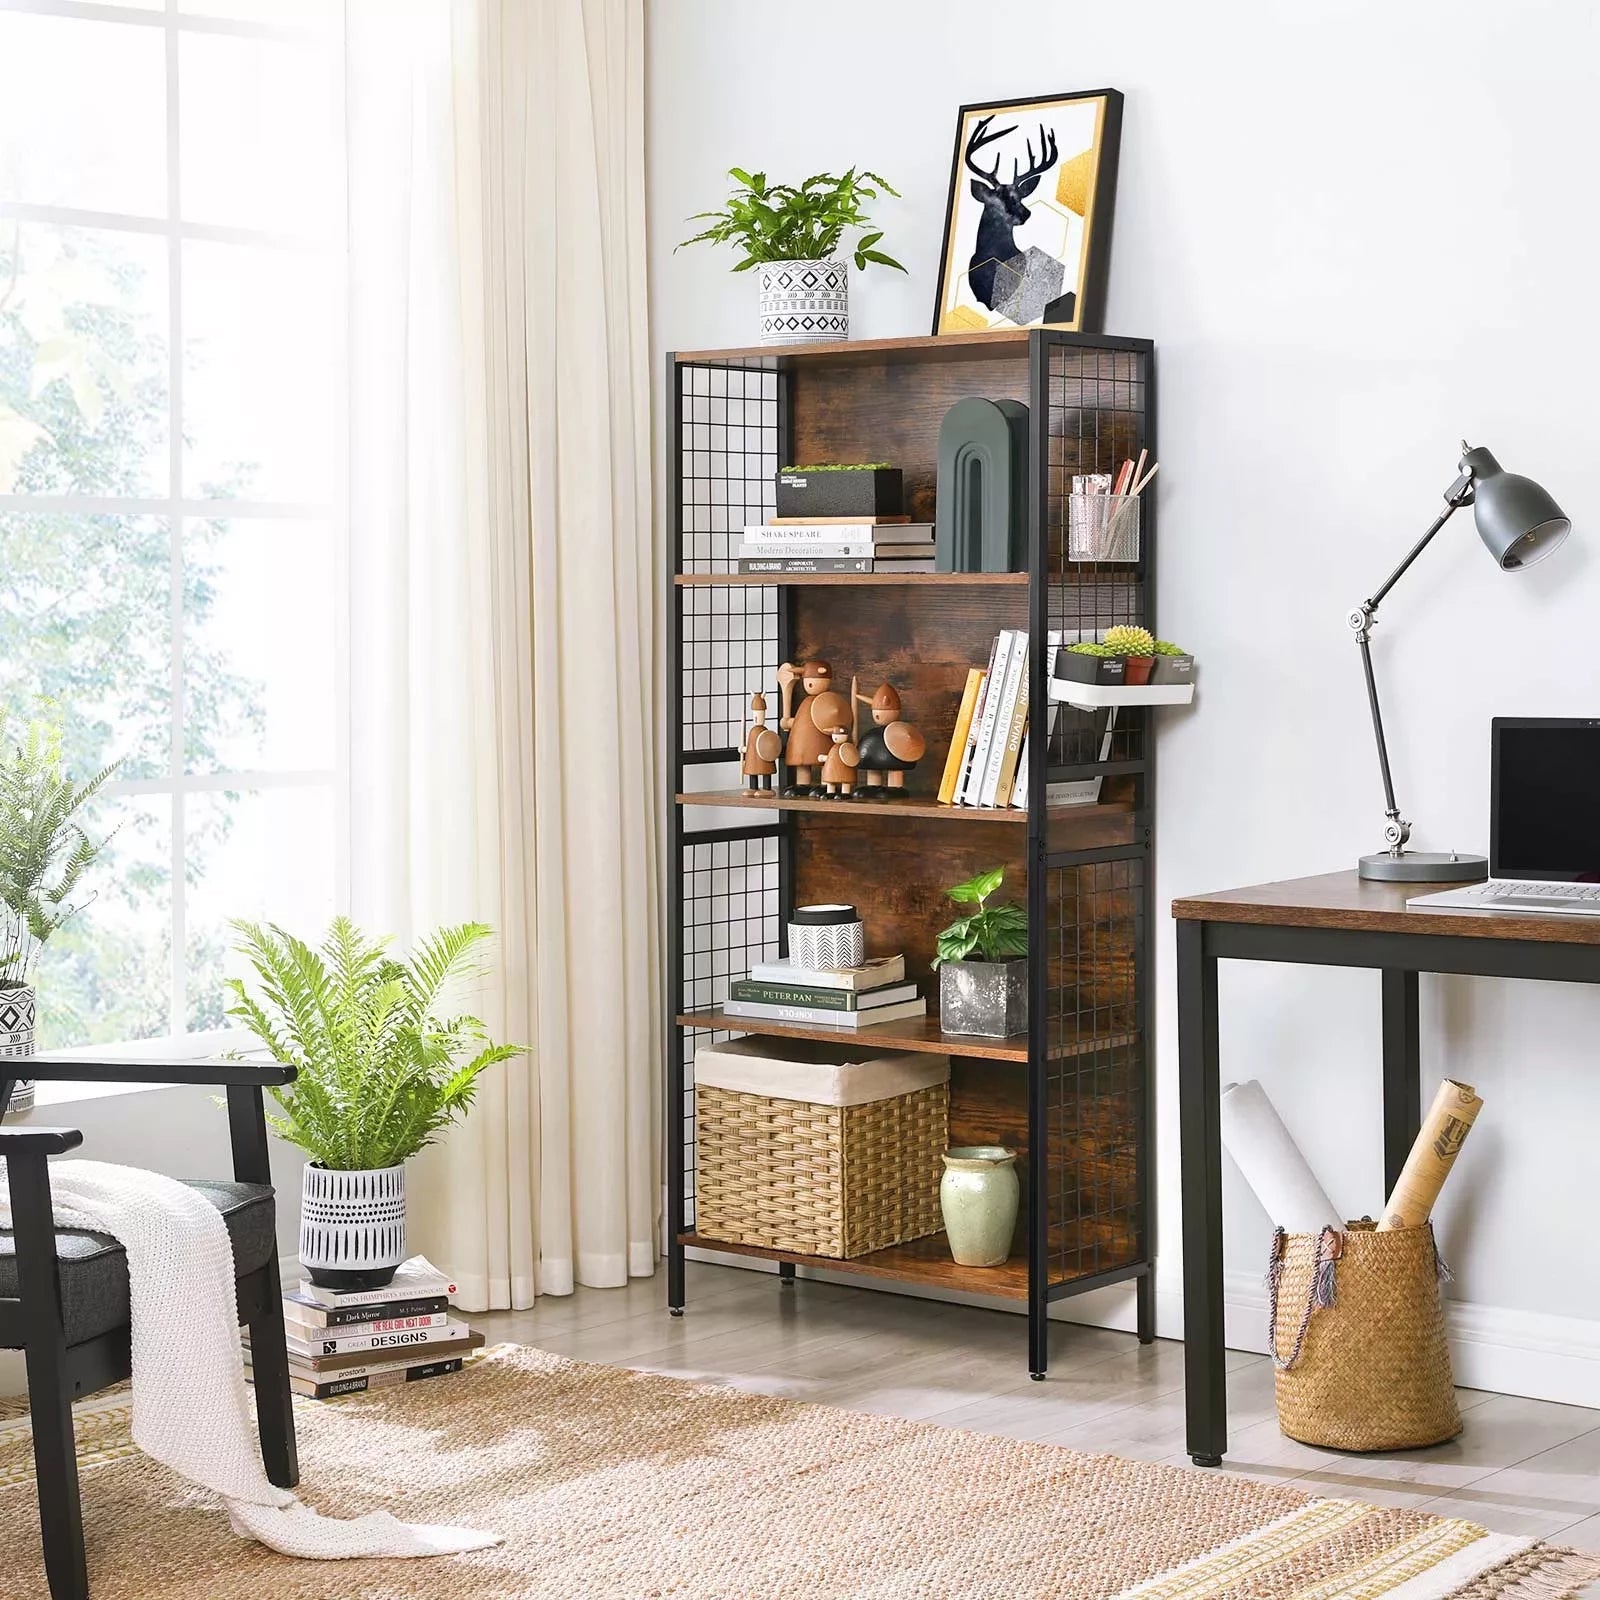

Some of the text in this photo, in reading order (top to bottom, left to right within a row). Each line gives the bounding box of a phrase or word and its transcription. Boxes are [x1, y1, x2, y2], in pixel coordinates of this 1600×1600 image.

[760, 530, 822, 539] SHAKESPEARE
[756, 545, 824, 554] Modern Decoration
[1009, 713, 1023, 752] LIVING
[763, 990, 791, 1001] PETER
[793, 993, 812, 1002] PAN
[777, 1008, 813, 1019] KINFOLK
[340, 1295, 359, 1305] JOHN
[359, 1291, 398, 1303] HUMPHRYS
[345, 1311, 380, 1322] Dark Mirror
[373, 1321, 382, 1331] THE
[382, 1320, 394, 1330] REAL
[395, 1319, 405, 1329] GIRL
[406, 1317, 418, 1328] NEXT
[419, 1315, 432, 1326] DOOR
[347, 1331, 428, 1348] GREAT DESIGNS
[338, 1367, 367, 1379] prostoria
